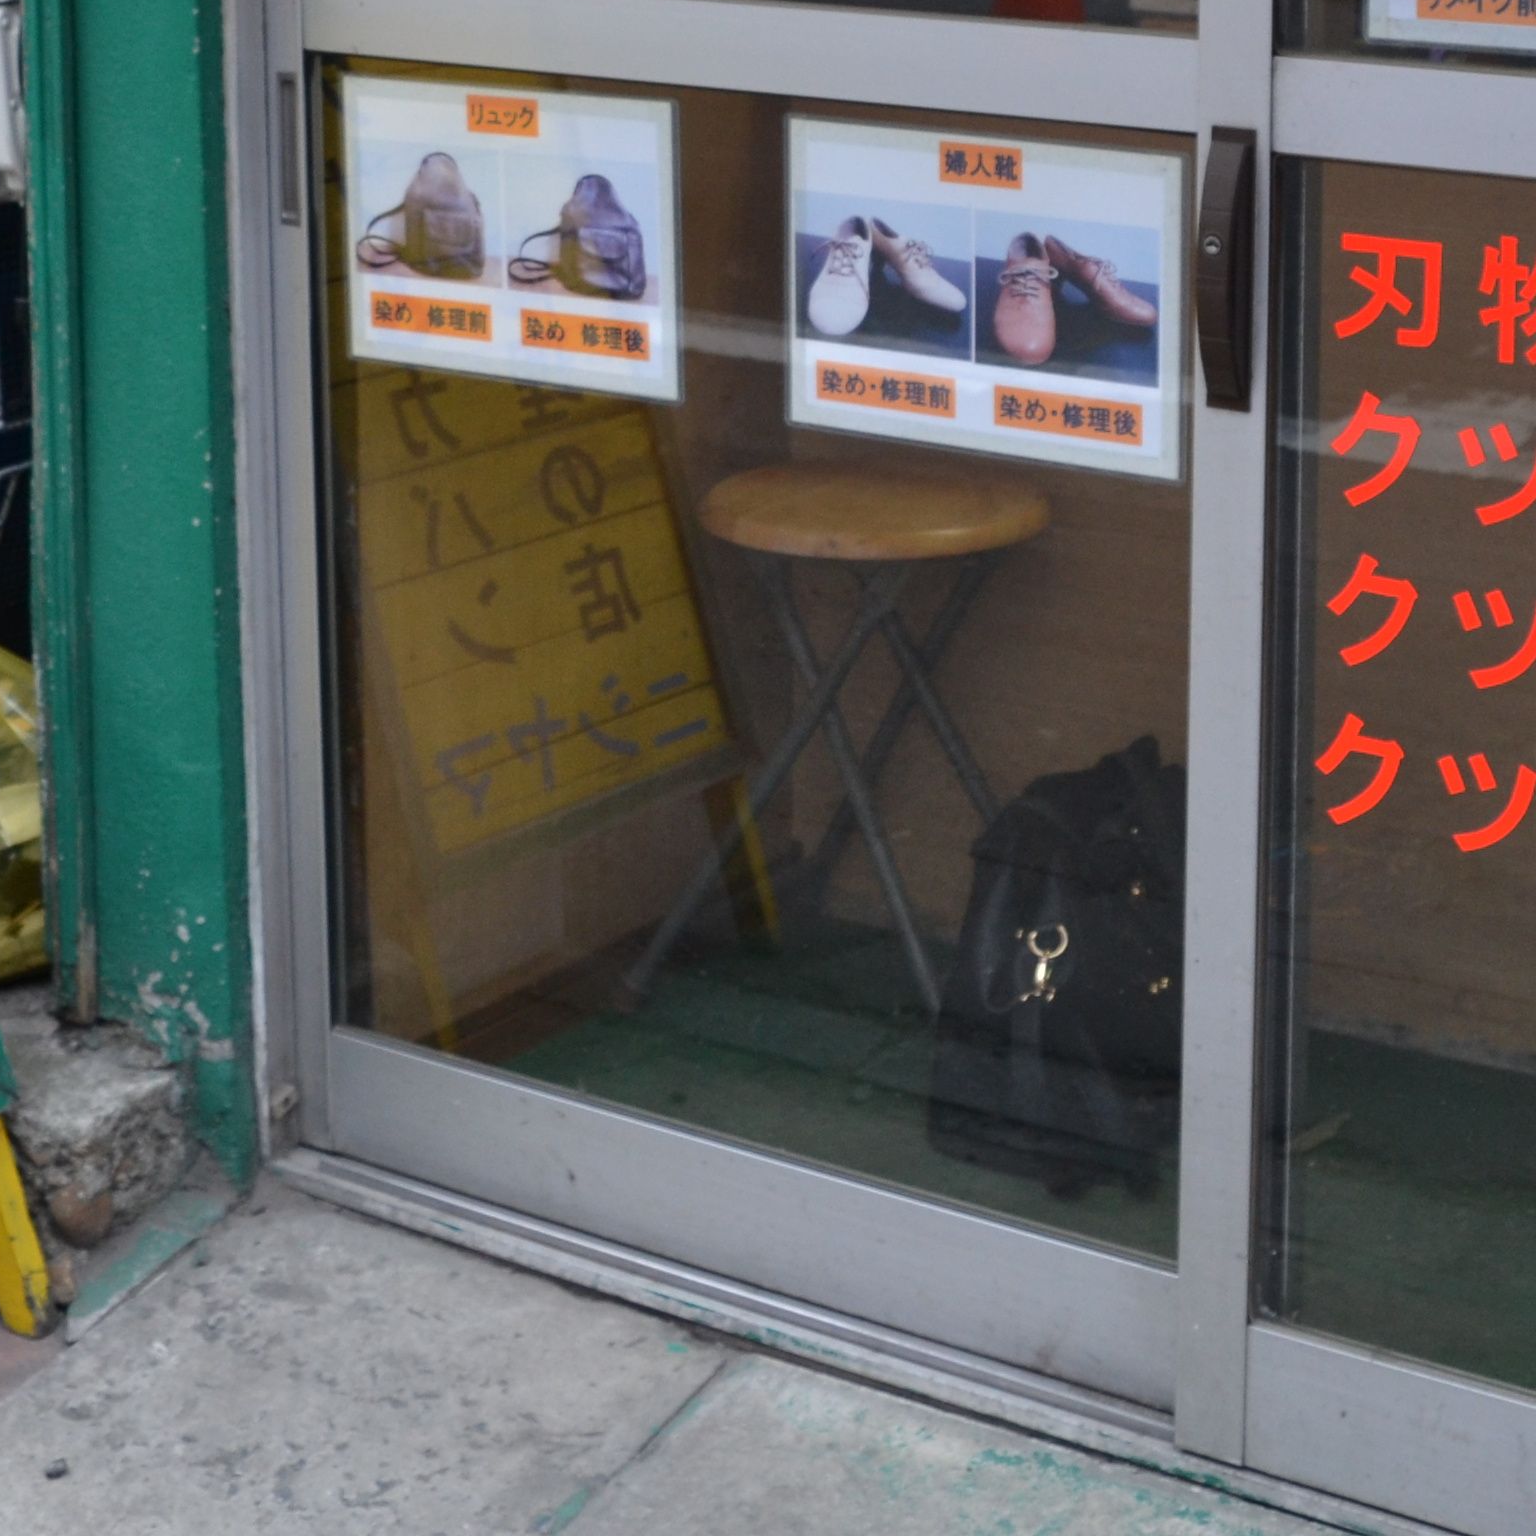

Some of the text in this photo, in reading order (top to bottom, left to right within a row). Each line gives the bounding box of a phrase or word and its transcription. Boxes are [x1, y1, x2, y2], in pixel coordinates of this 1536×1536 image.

[470, 103, 537, 129] リュック
[944, 149, 1019, 183] 婦人靴
[375, 300, 488, 335] 染め 修理前
[525, 316, 647, 354] 染め 修理後
[821, 368, 951, 411] 染め・修理前
[1000, 394, 1139, 438] 染め・修理後
